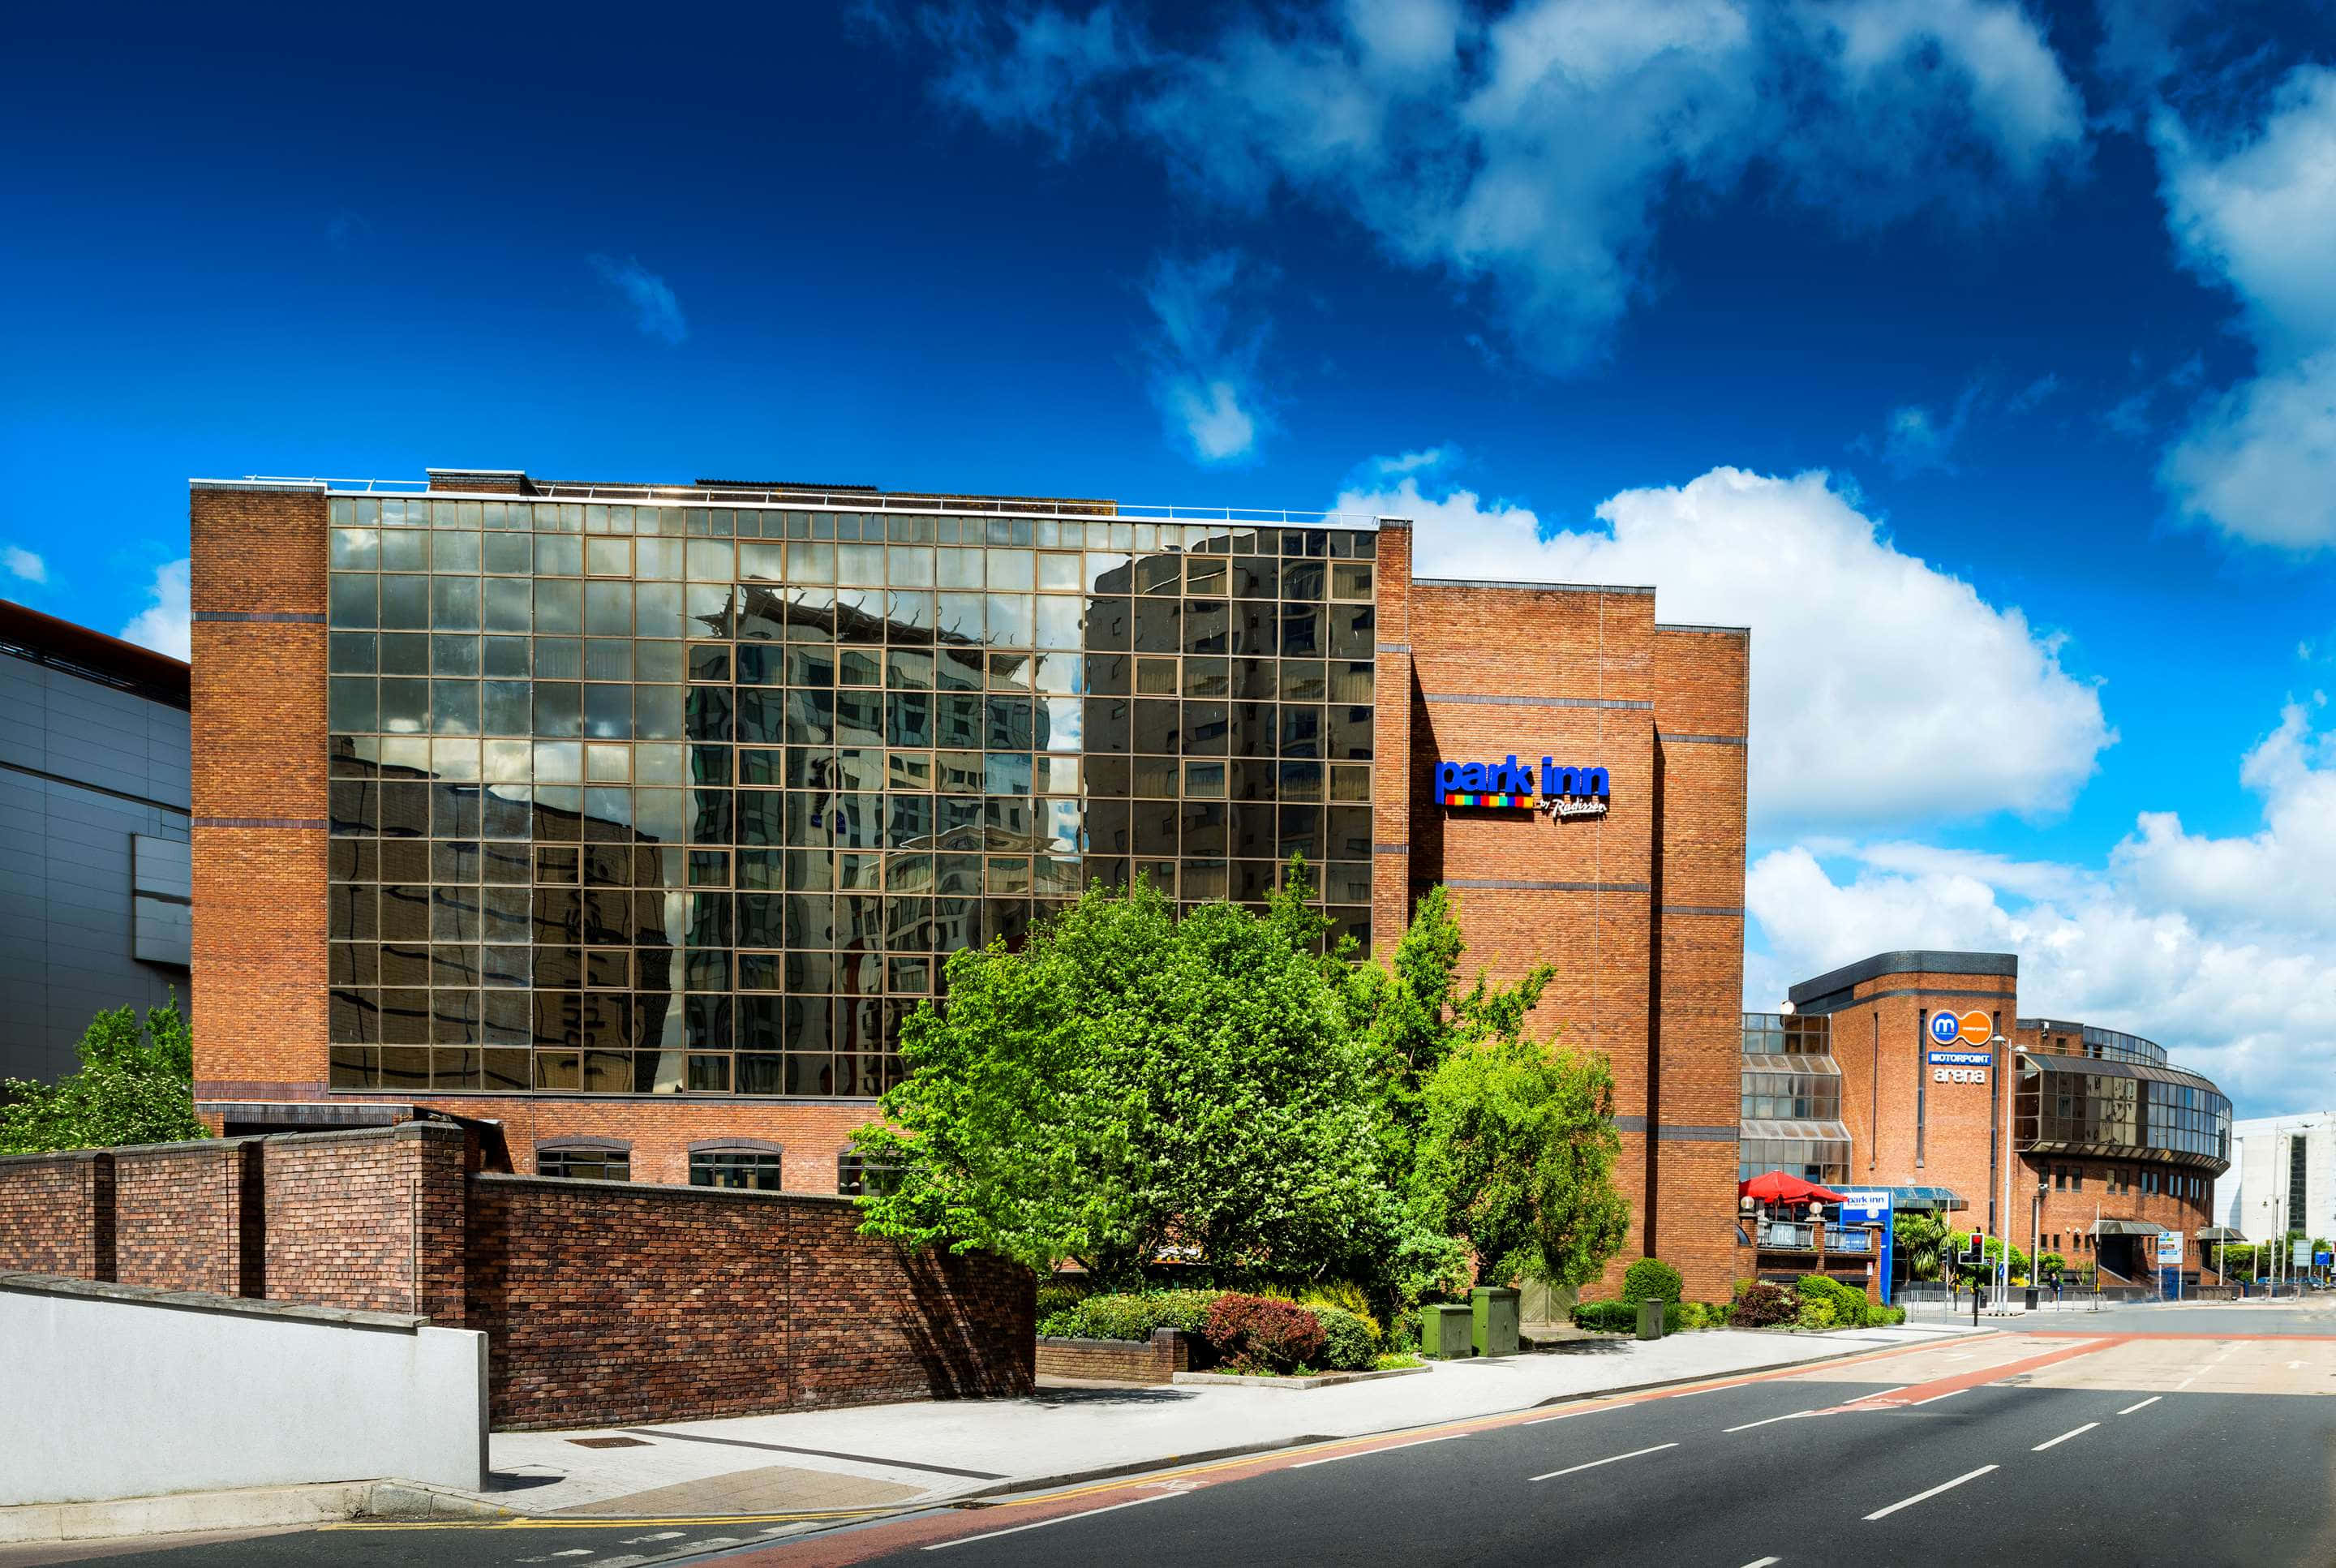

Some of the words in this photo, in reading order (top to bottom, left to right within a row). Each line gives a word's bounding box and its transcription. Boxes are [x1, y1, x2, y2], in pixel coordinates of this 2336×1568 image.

[1435, 754, 1534, 805] park
[1542, 756, 1609, 796] inn
[1552, 796, 1607, 818] Radisson
[1931, 1054, 1990, 1063] MOTORPOINT
[1934, 1068, 1986, 1084] arena
[1848, 1196, 1867, 1205] park
